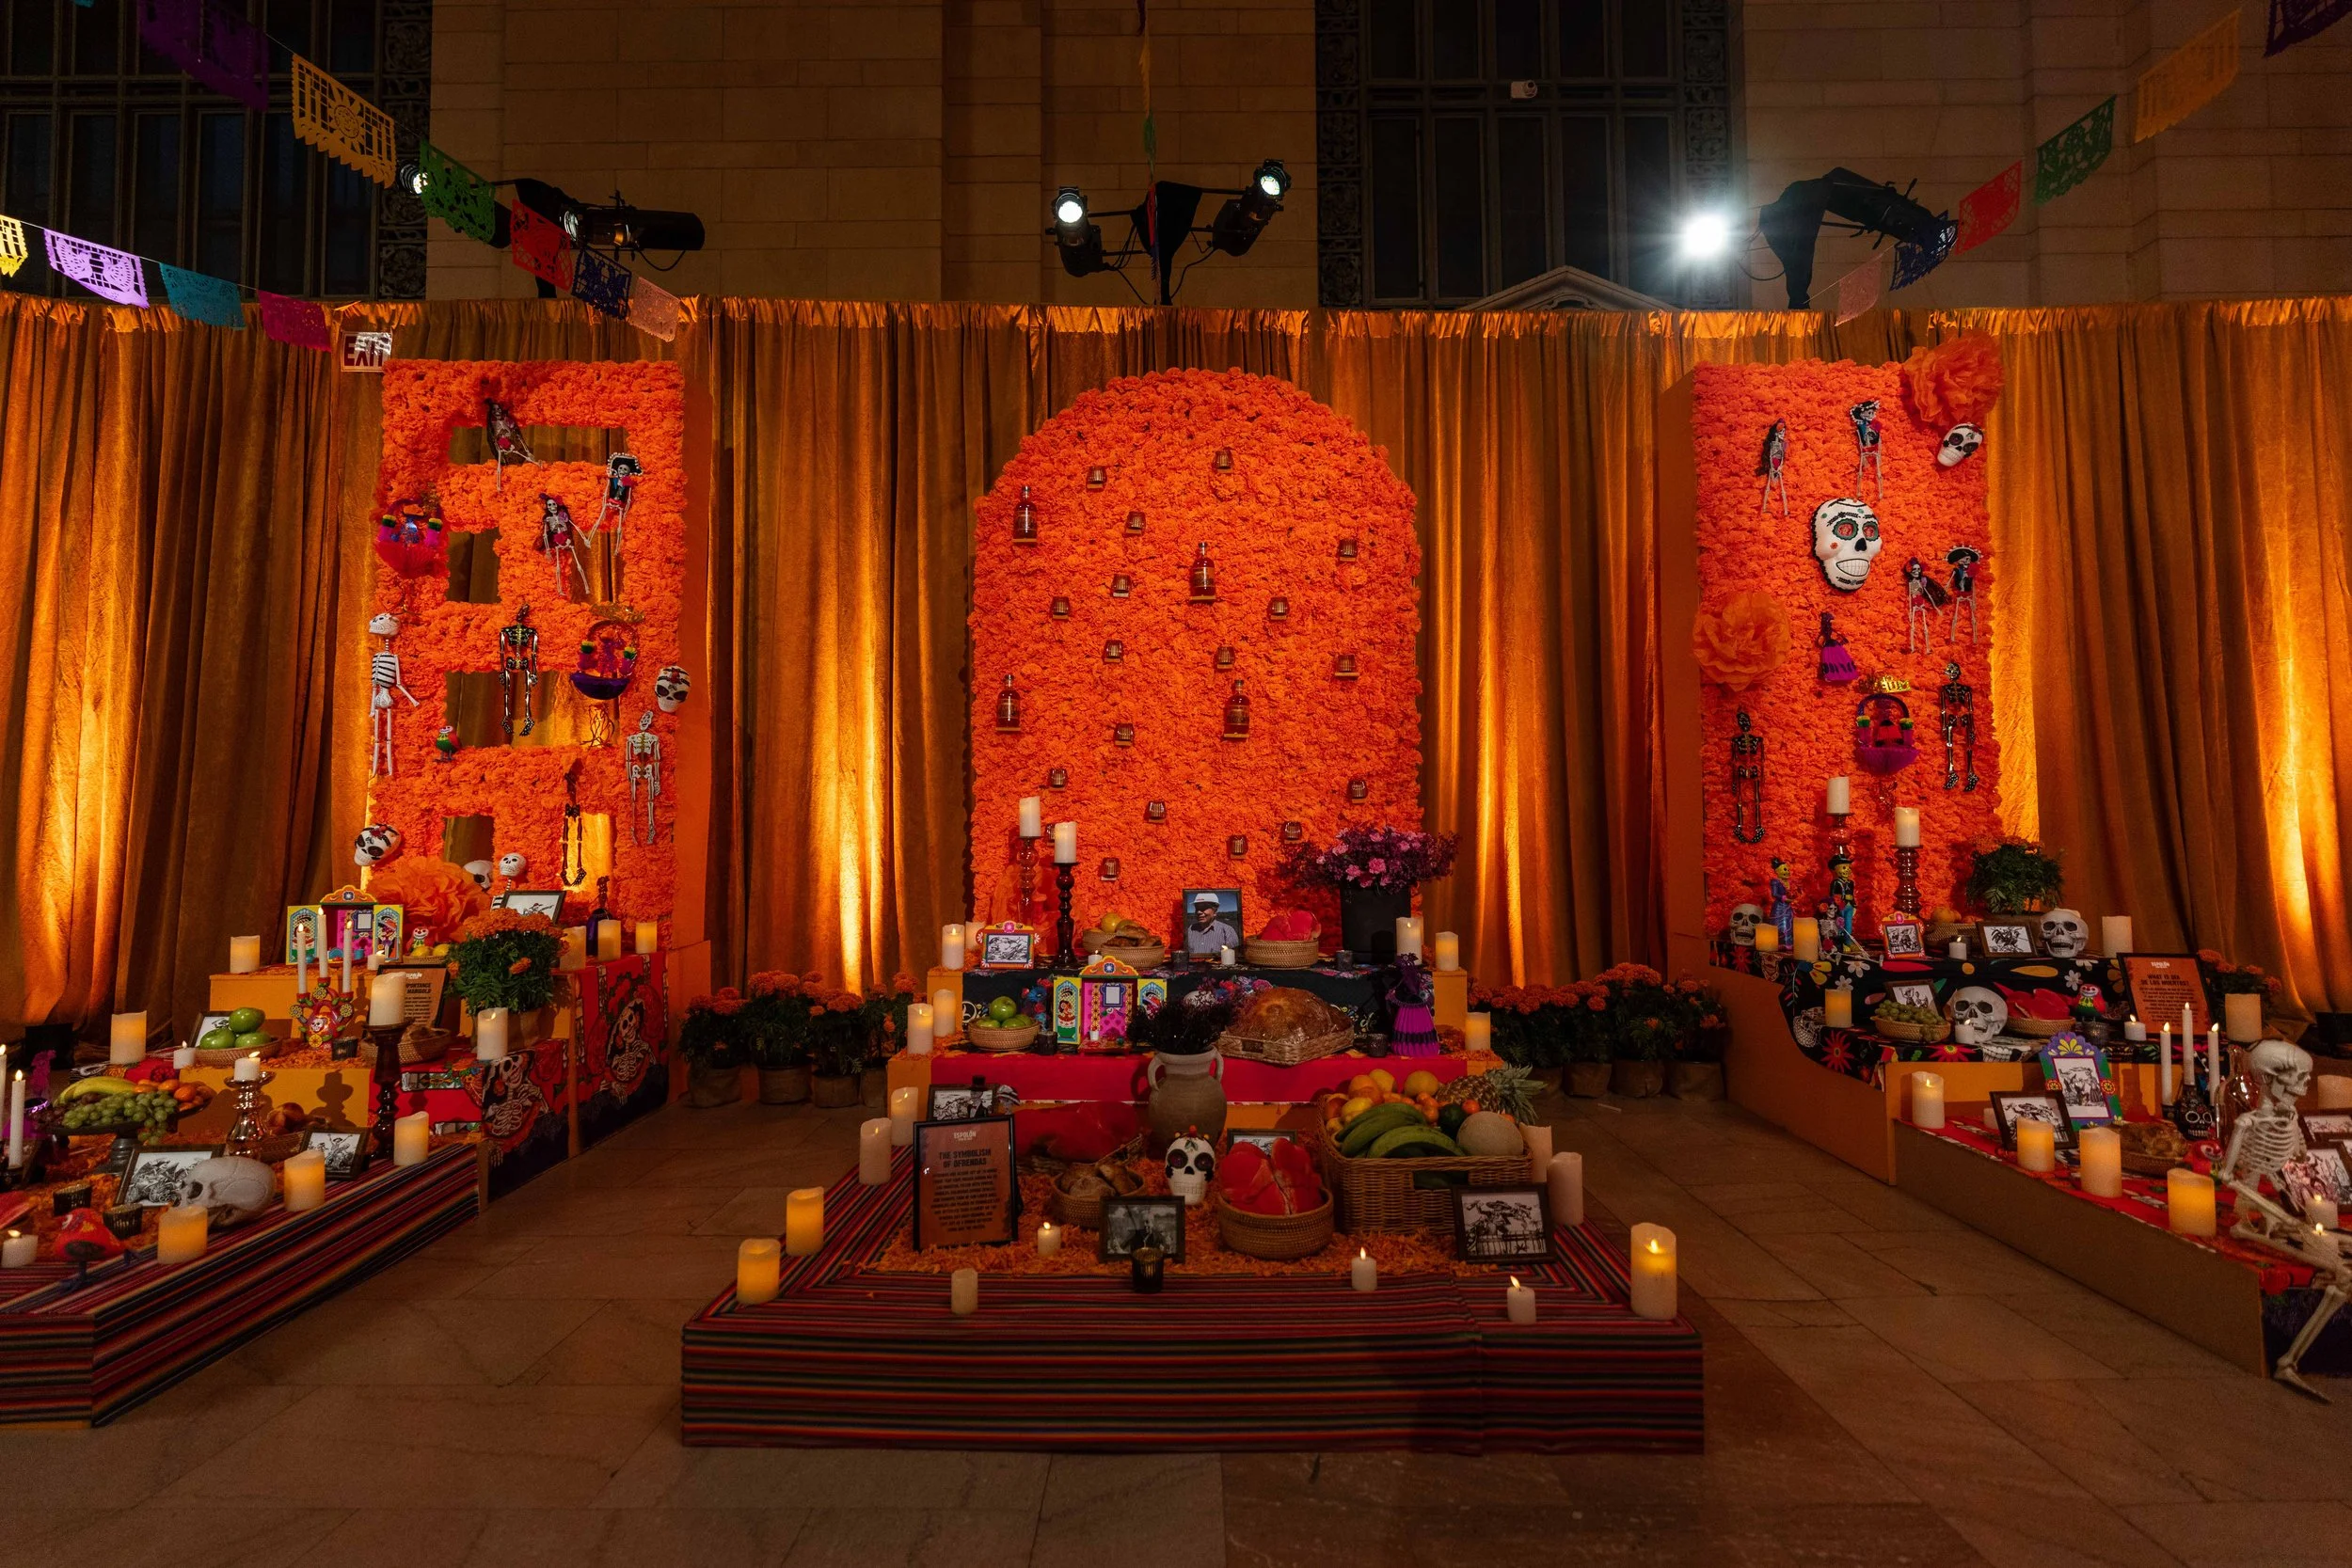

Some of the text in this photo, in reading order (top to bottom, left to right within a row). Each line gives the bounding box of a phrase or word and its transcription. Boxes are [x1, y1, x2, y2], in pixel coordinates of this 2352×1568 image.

[344, 336, 387, 366] EXIT
[939, 1148, 992, 1160] THE SYMBOLISM
[953, 1158, 987, 1167] OFRENDAS
